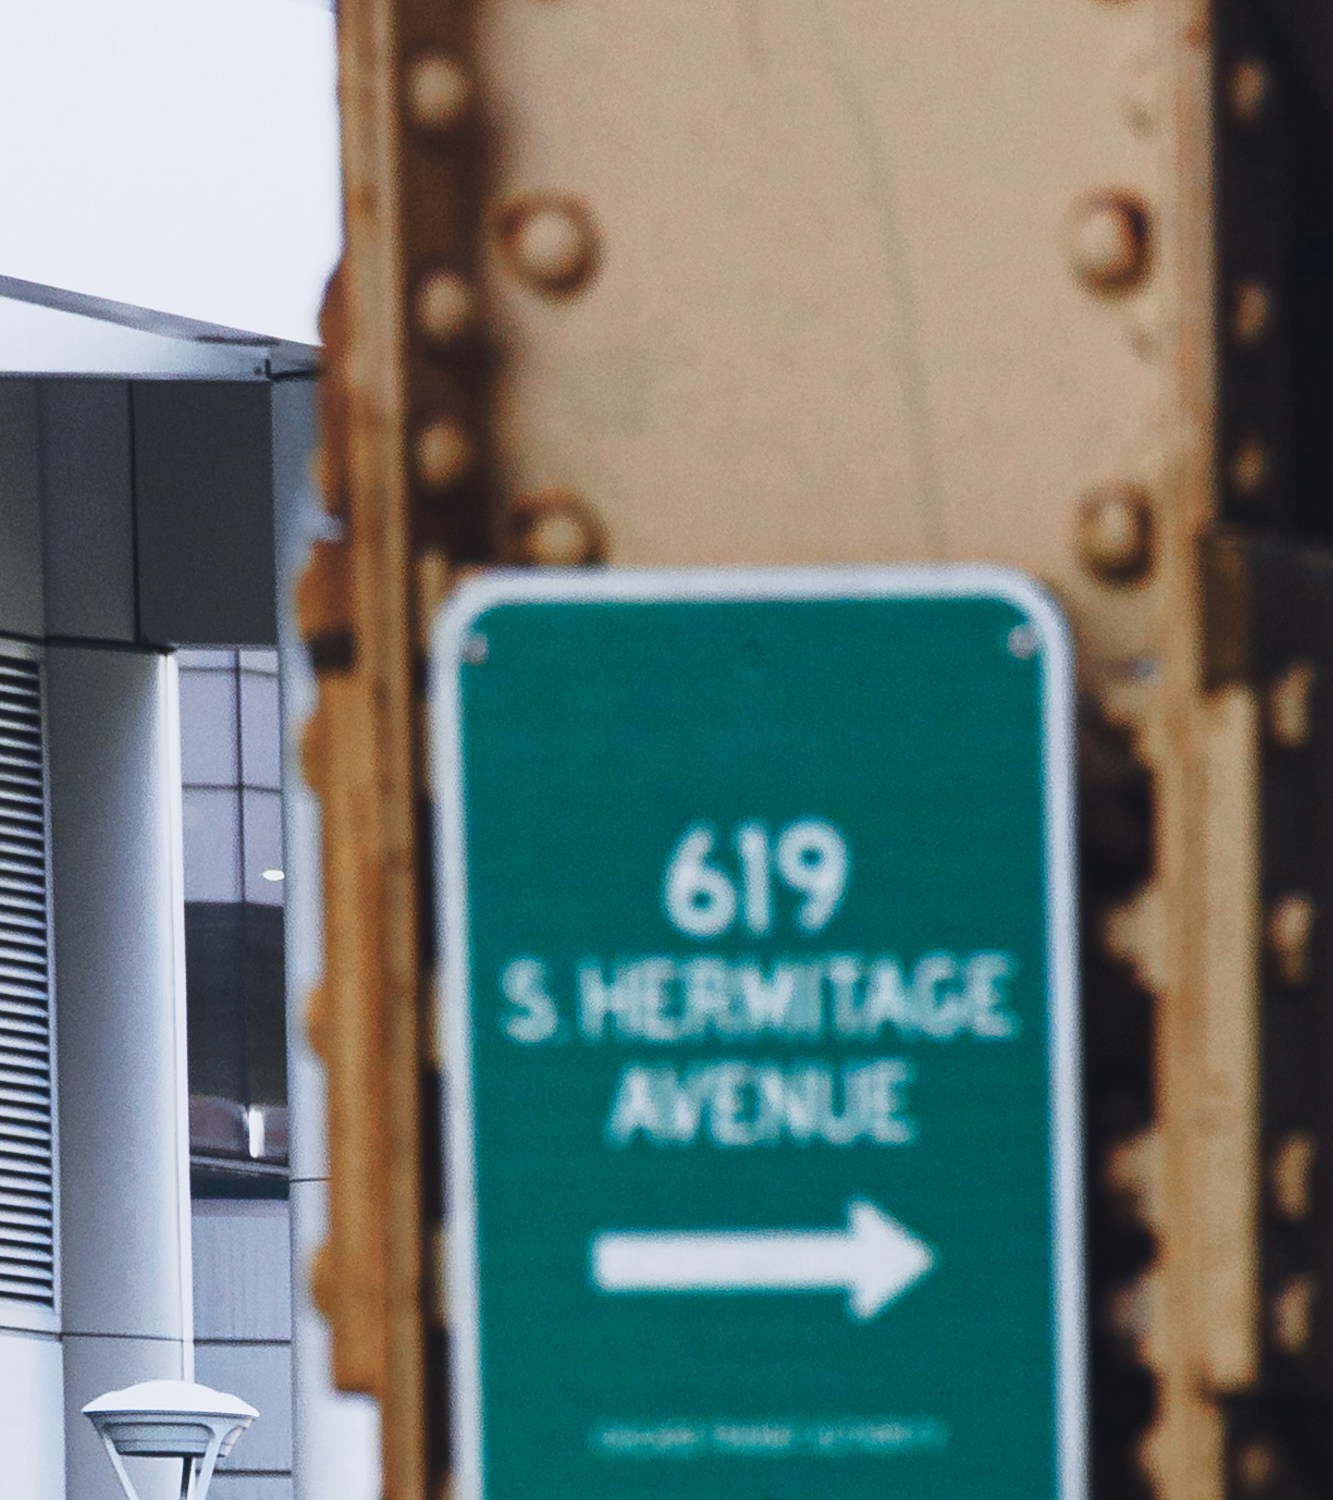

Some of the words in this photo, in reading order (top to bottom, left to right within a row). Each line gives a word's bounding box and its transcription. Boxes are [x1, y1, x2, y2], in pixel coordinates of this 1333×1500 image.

[662, 820, 850, 938] 619
[500, 956, 560, 1044] S
[579, 950, 1018, 1042] HERMITAGE
[609, 1058, 916, 1146] AVENUE
